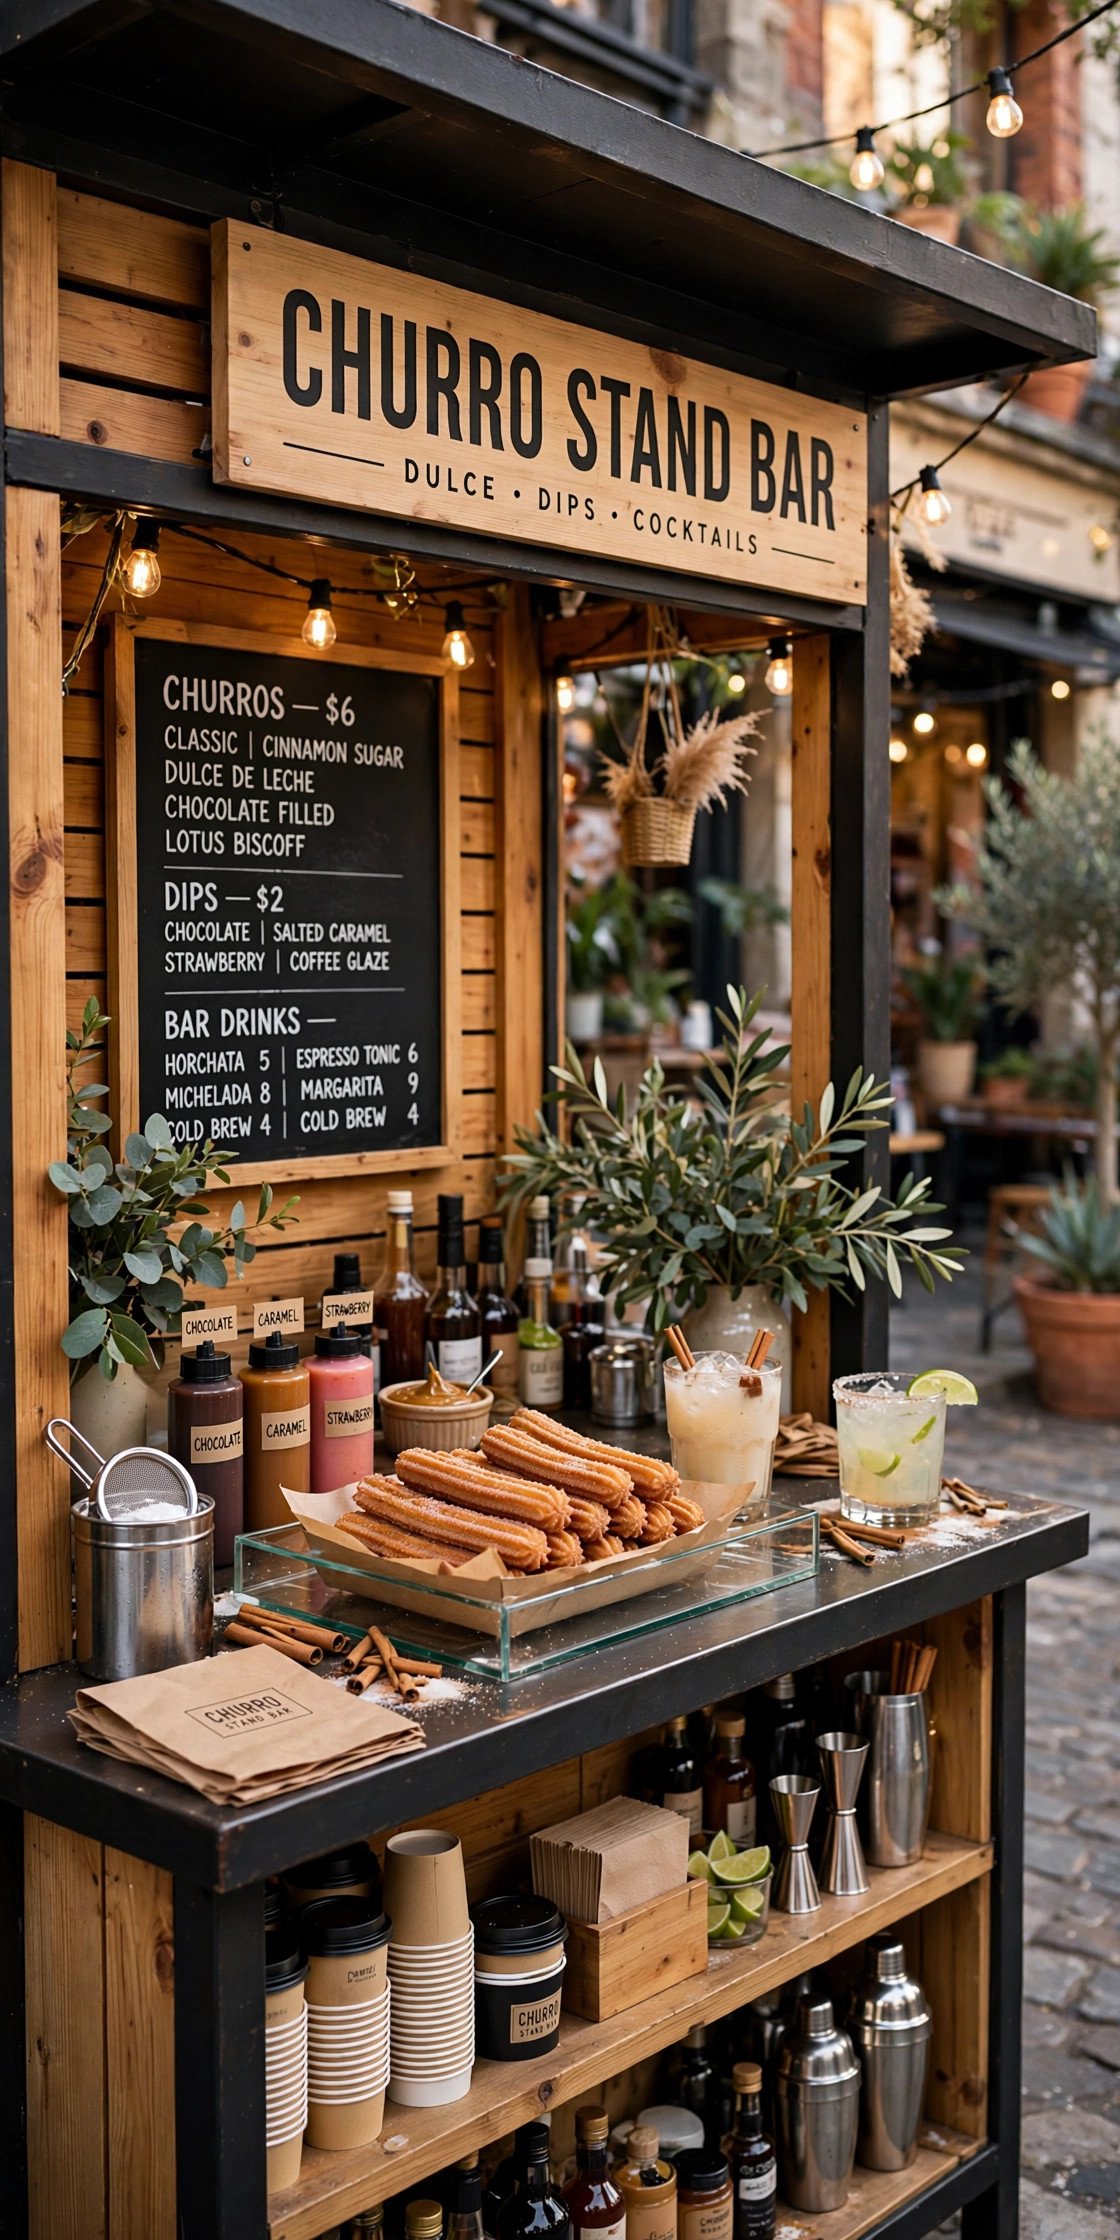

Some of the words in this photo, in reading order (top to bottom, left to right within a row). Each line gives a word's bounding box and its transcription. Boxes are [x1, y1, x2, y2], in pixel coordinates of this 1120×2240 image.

[282, 289, 542, 459] CHURRO
[567, 368, 730, 502] STAND
[751, 419, 835, 531] BAR
[405, 459, 495, 500] DULCE
[539, 488, 594, 521] DIPS
[634, 510, 758, 555] COCKTAILS
[163, 675, 285, 720] CHURROS
[326, 693, 355, 726] $6
[165, 726, 238, 754] CLASSIC
[263, 735, 347, 763] CINNAMON
[354, 743, 404, 769] SUGAR
[165, 760, 223, 787] DULCE
[232, 765, 254, 789] DE
[264, 768, 314, 793] LECHE
[165, 795, 269, 823] CHOCOLATE
[279, 801, 334, 826] FILLED
[166, 830, 224, 854] LOTUS
[234, 832, 305, 857] BISCOFF
[165, 882, 218, 912] DIPS
[256, 885, 284, 913] $2
[165, 922, 250, 942] CHOCOLATE
[273, 923, 323, 943] SALTED
[329, 923, 391, 943] CARAMEL
[165, 951, 265, 972] STRAWBERRY
[290, 952, 340, 971] COFFEE
[347, 951, 389, 971] GLAZE
[165, 1010, 209, 1039] BAR
[221, 1007, 300, 1036] DRINKS
[165, 1051, 245, 1075] HORCHATA
[259, 1050, 270, 1071] 5
[296, 1047, 358, 1069] ESPRESSO
[364, 1044, 400, 1064] TONIC
[408, 1043, 418, 1063] 6
[166, 1083, 252, 1109] MICHELADA
[260, 1082, 271, 1104] 8
[301, 1076, 384, 1100] MARGARITA
[408, 1073, 418, 1094] 9
[168, 1119, 204, 1143] COLD
[211, 1116, 252, 1140] BREW
[260, 1114, 271, 1136] 4
[301, 1110, 338, 1133] COLD
[346, 1107, 386, 1128] BREW
[407, 1103, 419, 1125] 4
[258, 1309, 299, 1327] CARAMEL
[325, 1301, 371, 1317] STRAWBERRY
[186, 1316, 233, 1334] CHOCOLATE
[195, 1431, 241, 1452] CHOCOLATE
[267, 1420, 307, 1437] CARAMEL
[205, 1696, 281, 1722] CHURRO
[225, 1715, 264, 1729] STAND
[268, 1707, 293, 1719] BAR
[519, 2000, 558, 2026] CHURRO
